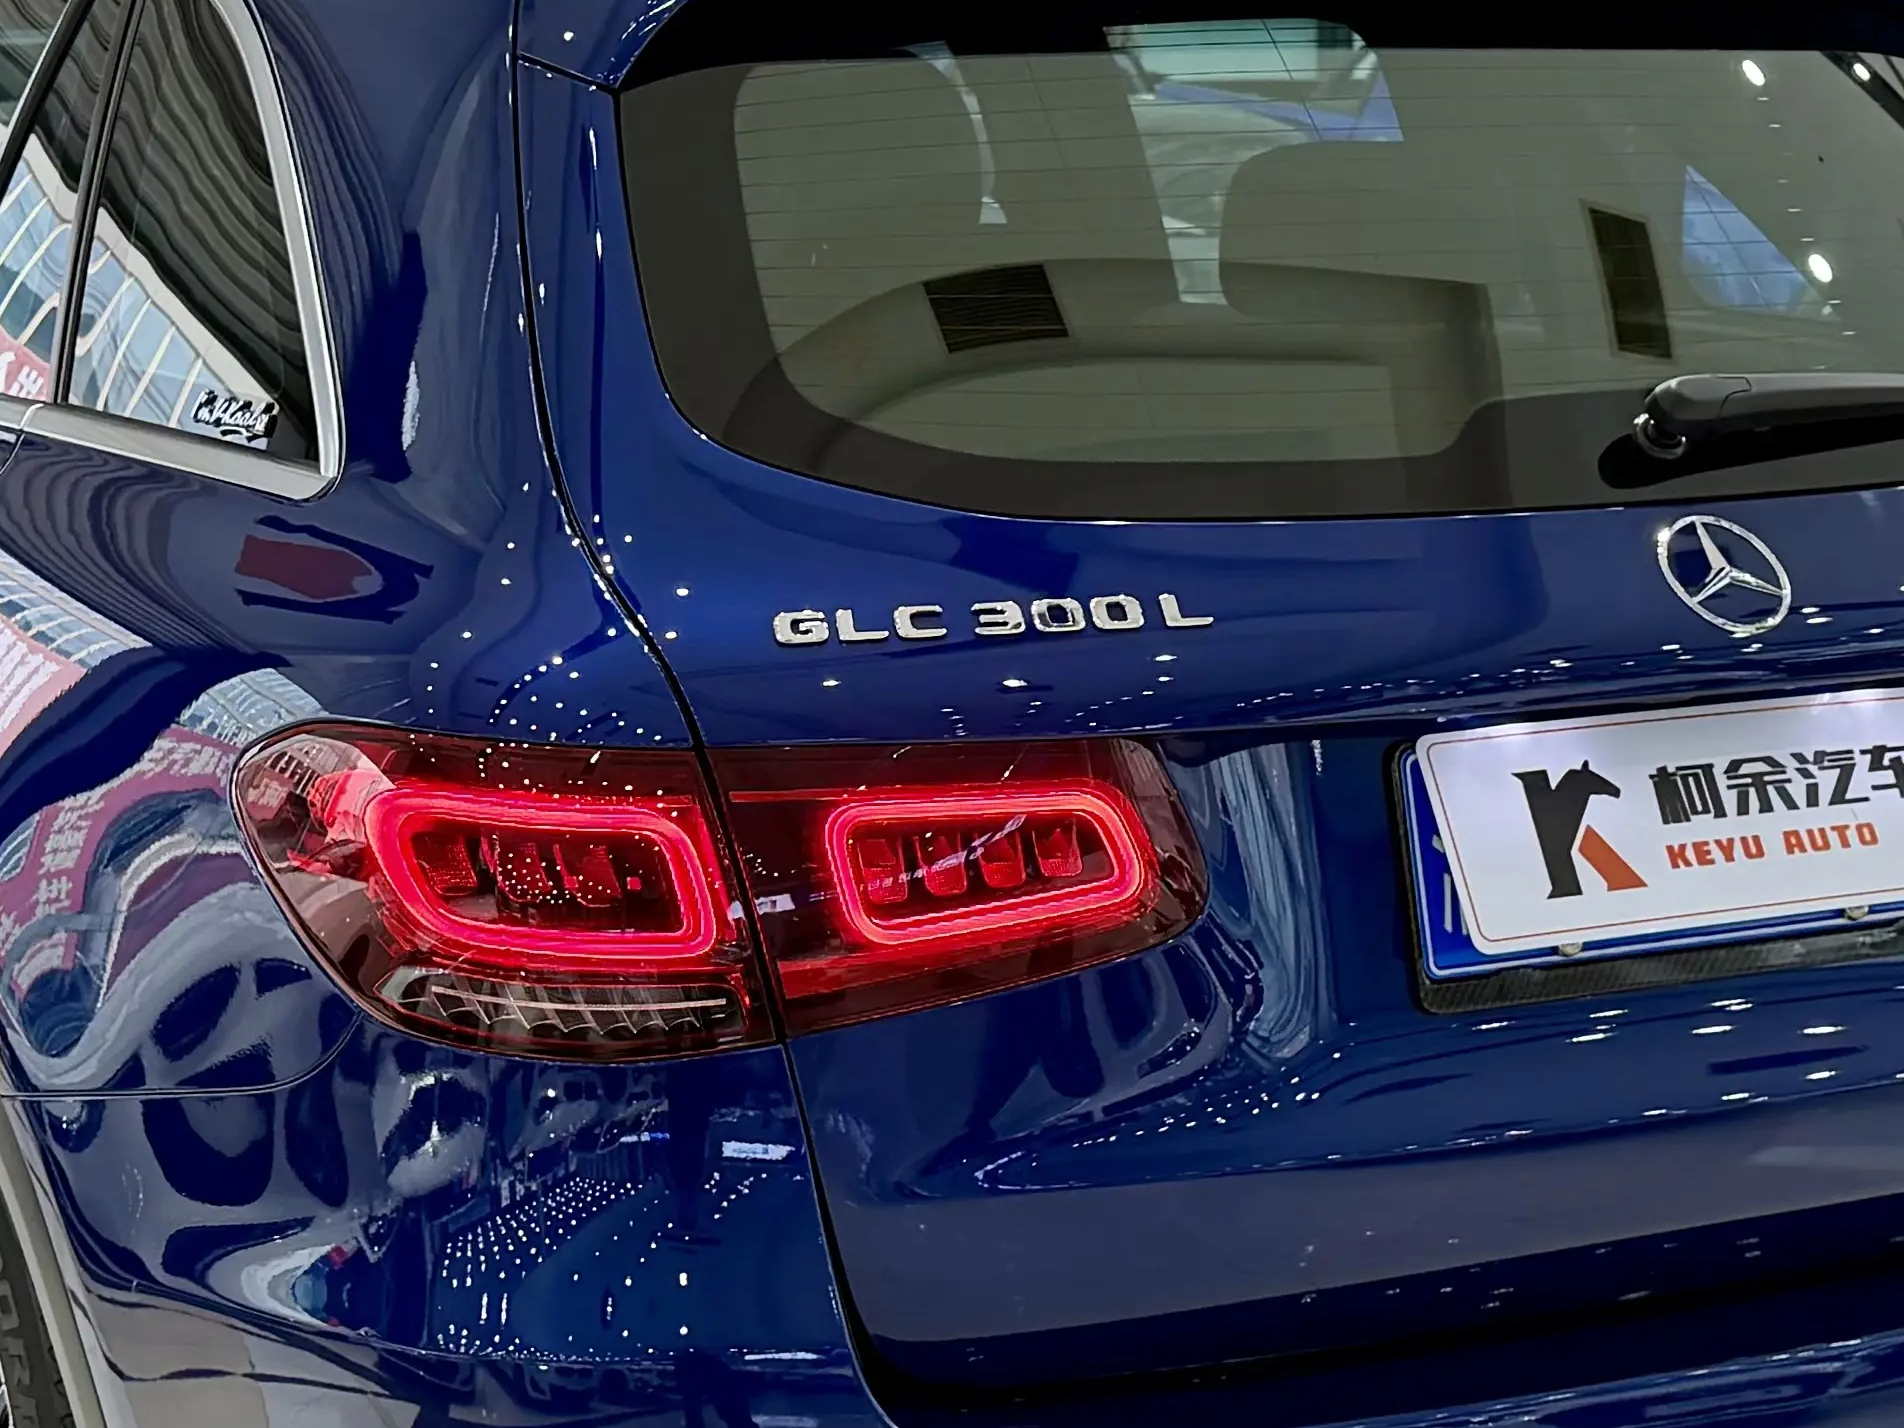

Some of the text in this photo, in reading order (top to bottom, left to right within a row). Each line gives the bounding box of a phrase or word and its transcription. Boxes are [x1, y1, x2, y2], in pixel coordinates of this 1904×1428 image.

[772, 604, 950, 647] GLC
[1666, 822, 1880, 870] KEYU AUTO
